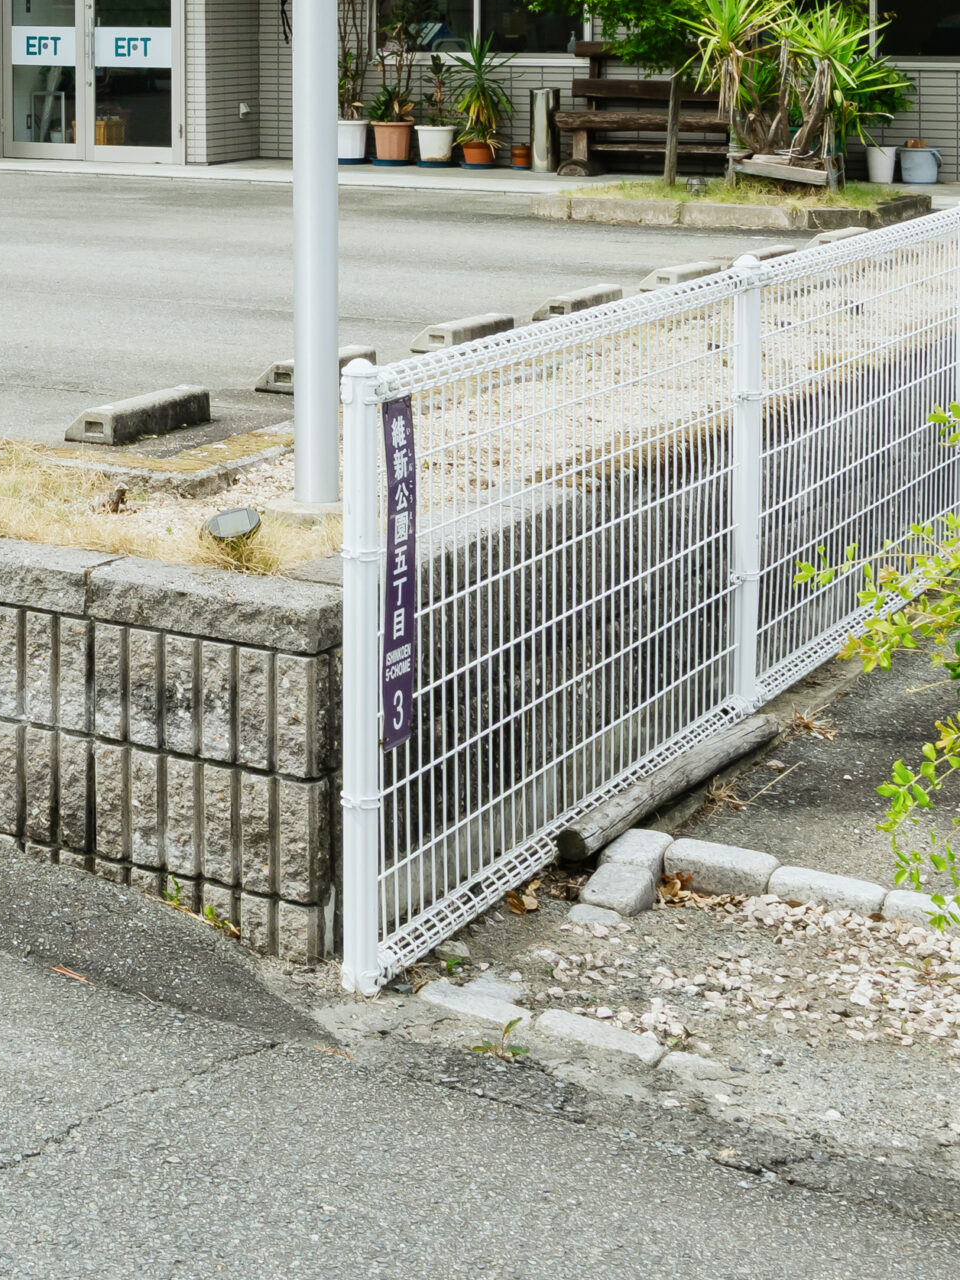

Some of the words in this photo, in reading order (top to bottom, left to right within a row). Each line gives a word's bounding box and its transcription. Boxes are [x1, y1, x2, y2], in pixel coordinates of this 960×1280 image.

[391, 415, 409, 640] 維新公園五丁目
[385, 658, 411, 682] 5-CHOME
[393, 689, 404, 731] 3
